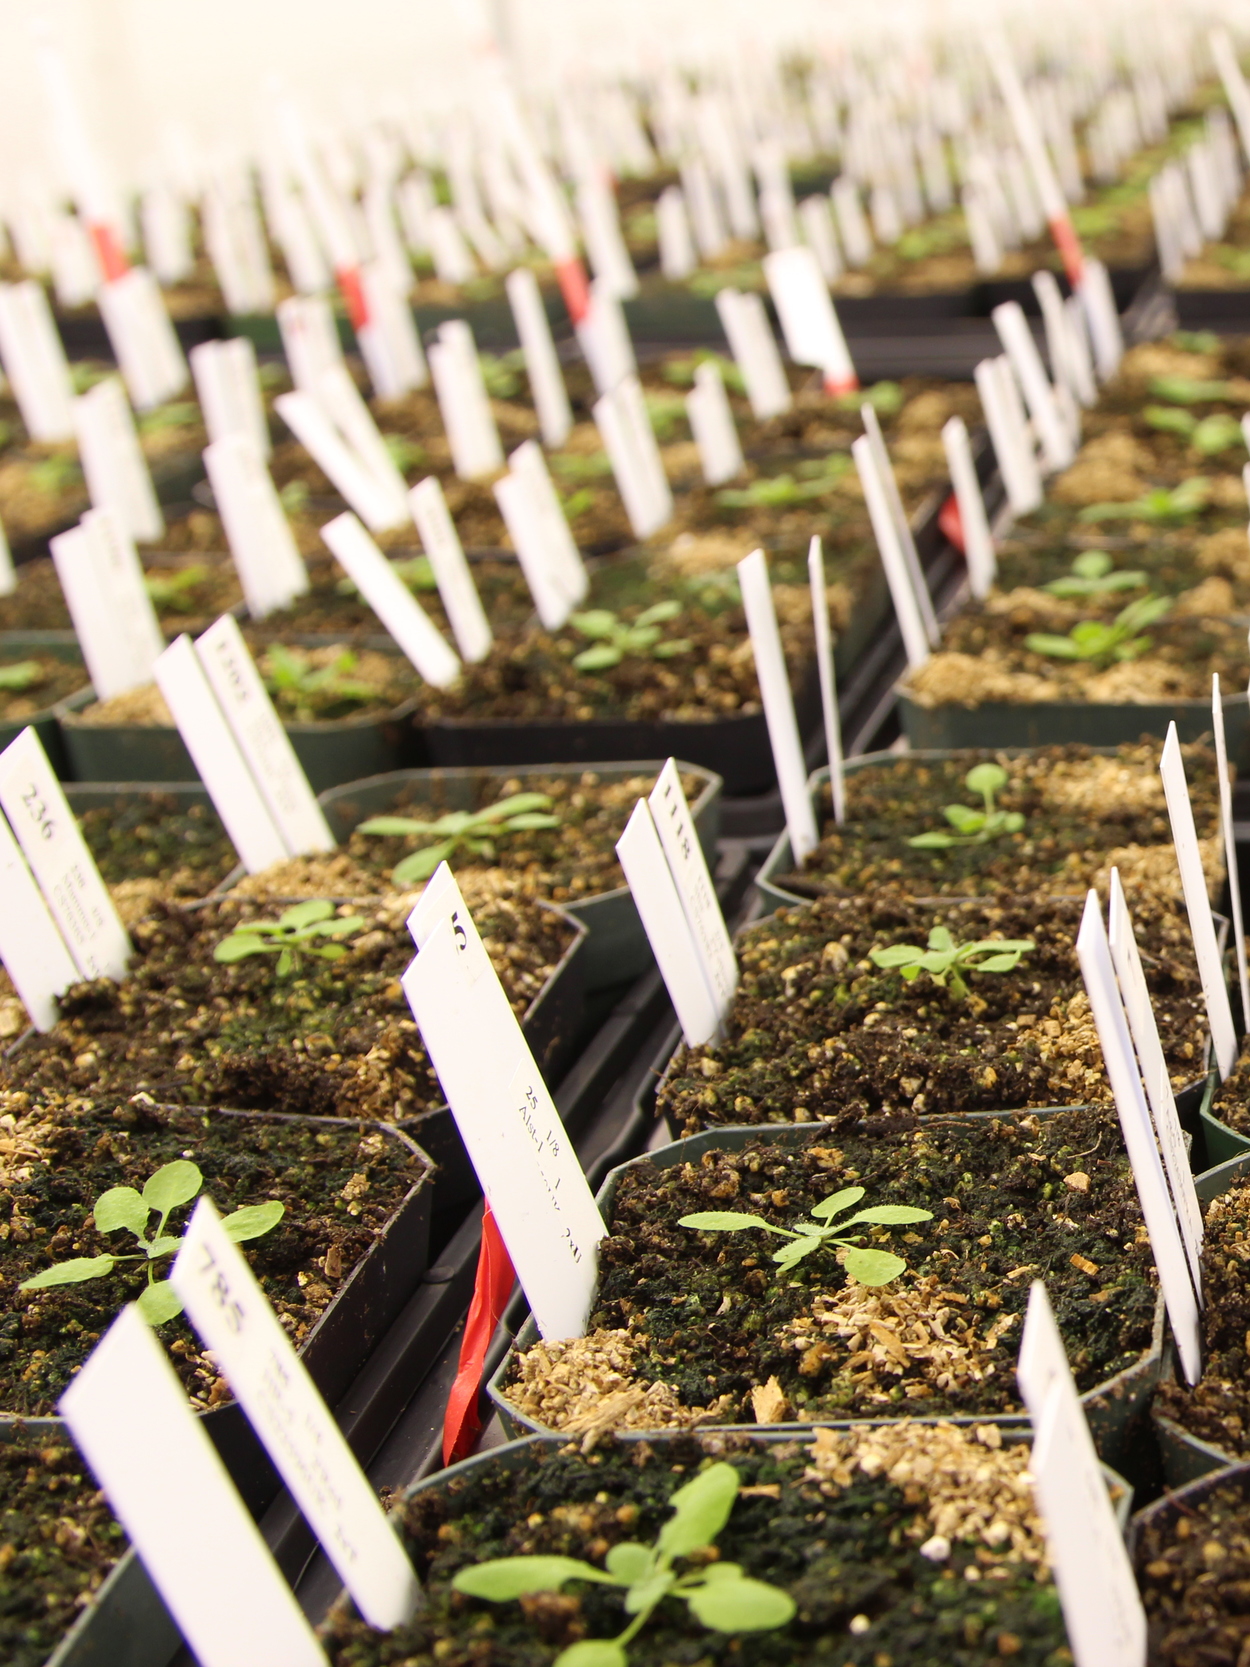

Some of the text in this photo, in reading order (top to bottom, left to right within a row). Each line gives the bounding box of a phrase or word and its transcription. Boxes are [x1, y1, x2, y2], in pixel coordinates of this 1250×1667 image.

[22, 782, 54, 840] 236
[664, 784, 691, 861] 1118
[525, 1085, 539, 1110] 25
[546, 1129, 560, 1157] 1/8
[200, 1243, 246, 1334] 785
